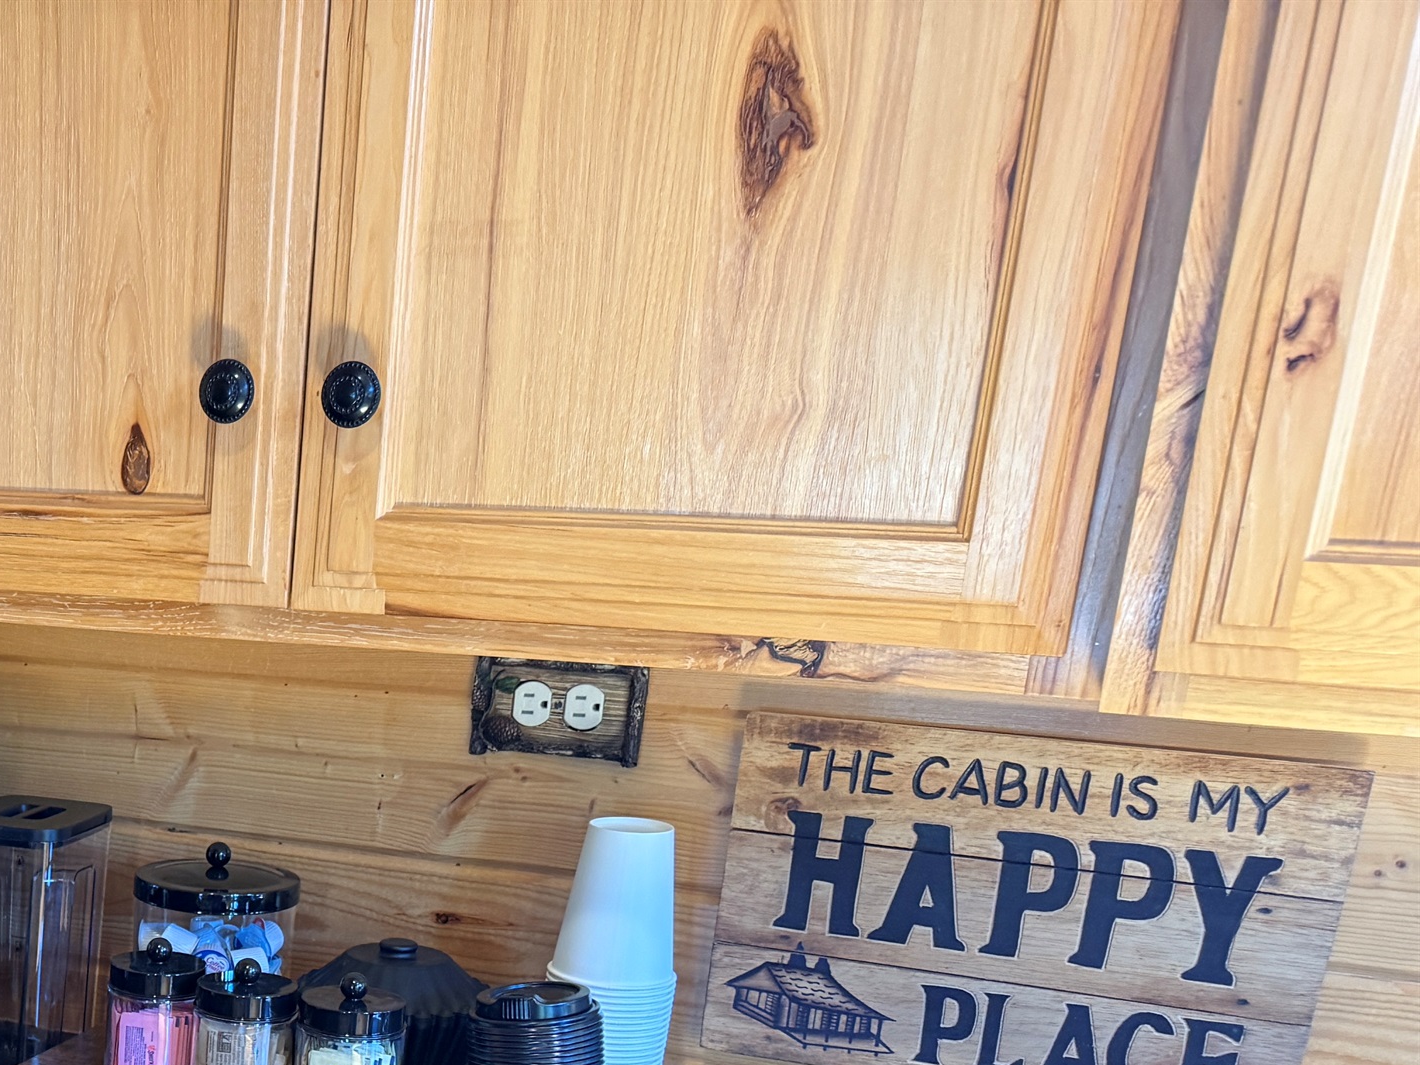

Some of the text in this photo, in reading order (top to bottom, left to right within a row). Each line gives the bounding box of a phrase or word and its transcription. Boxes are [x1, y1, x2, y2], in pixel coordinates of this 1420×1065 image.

[788, 743, 1290, 835] THE CABIN IS MY
[772, 809, 1284, 988] HAPPY
